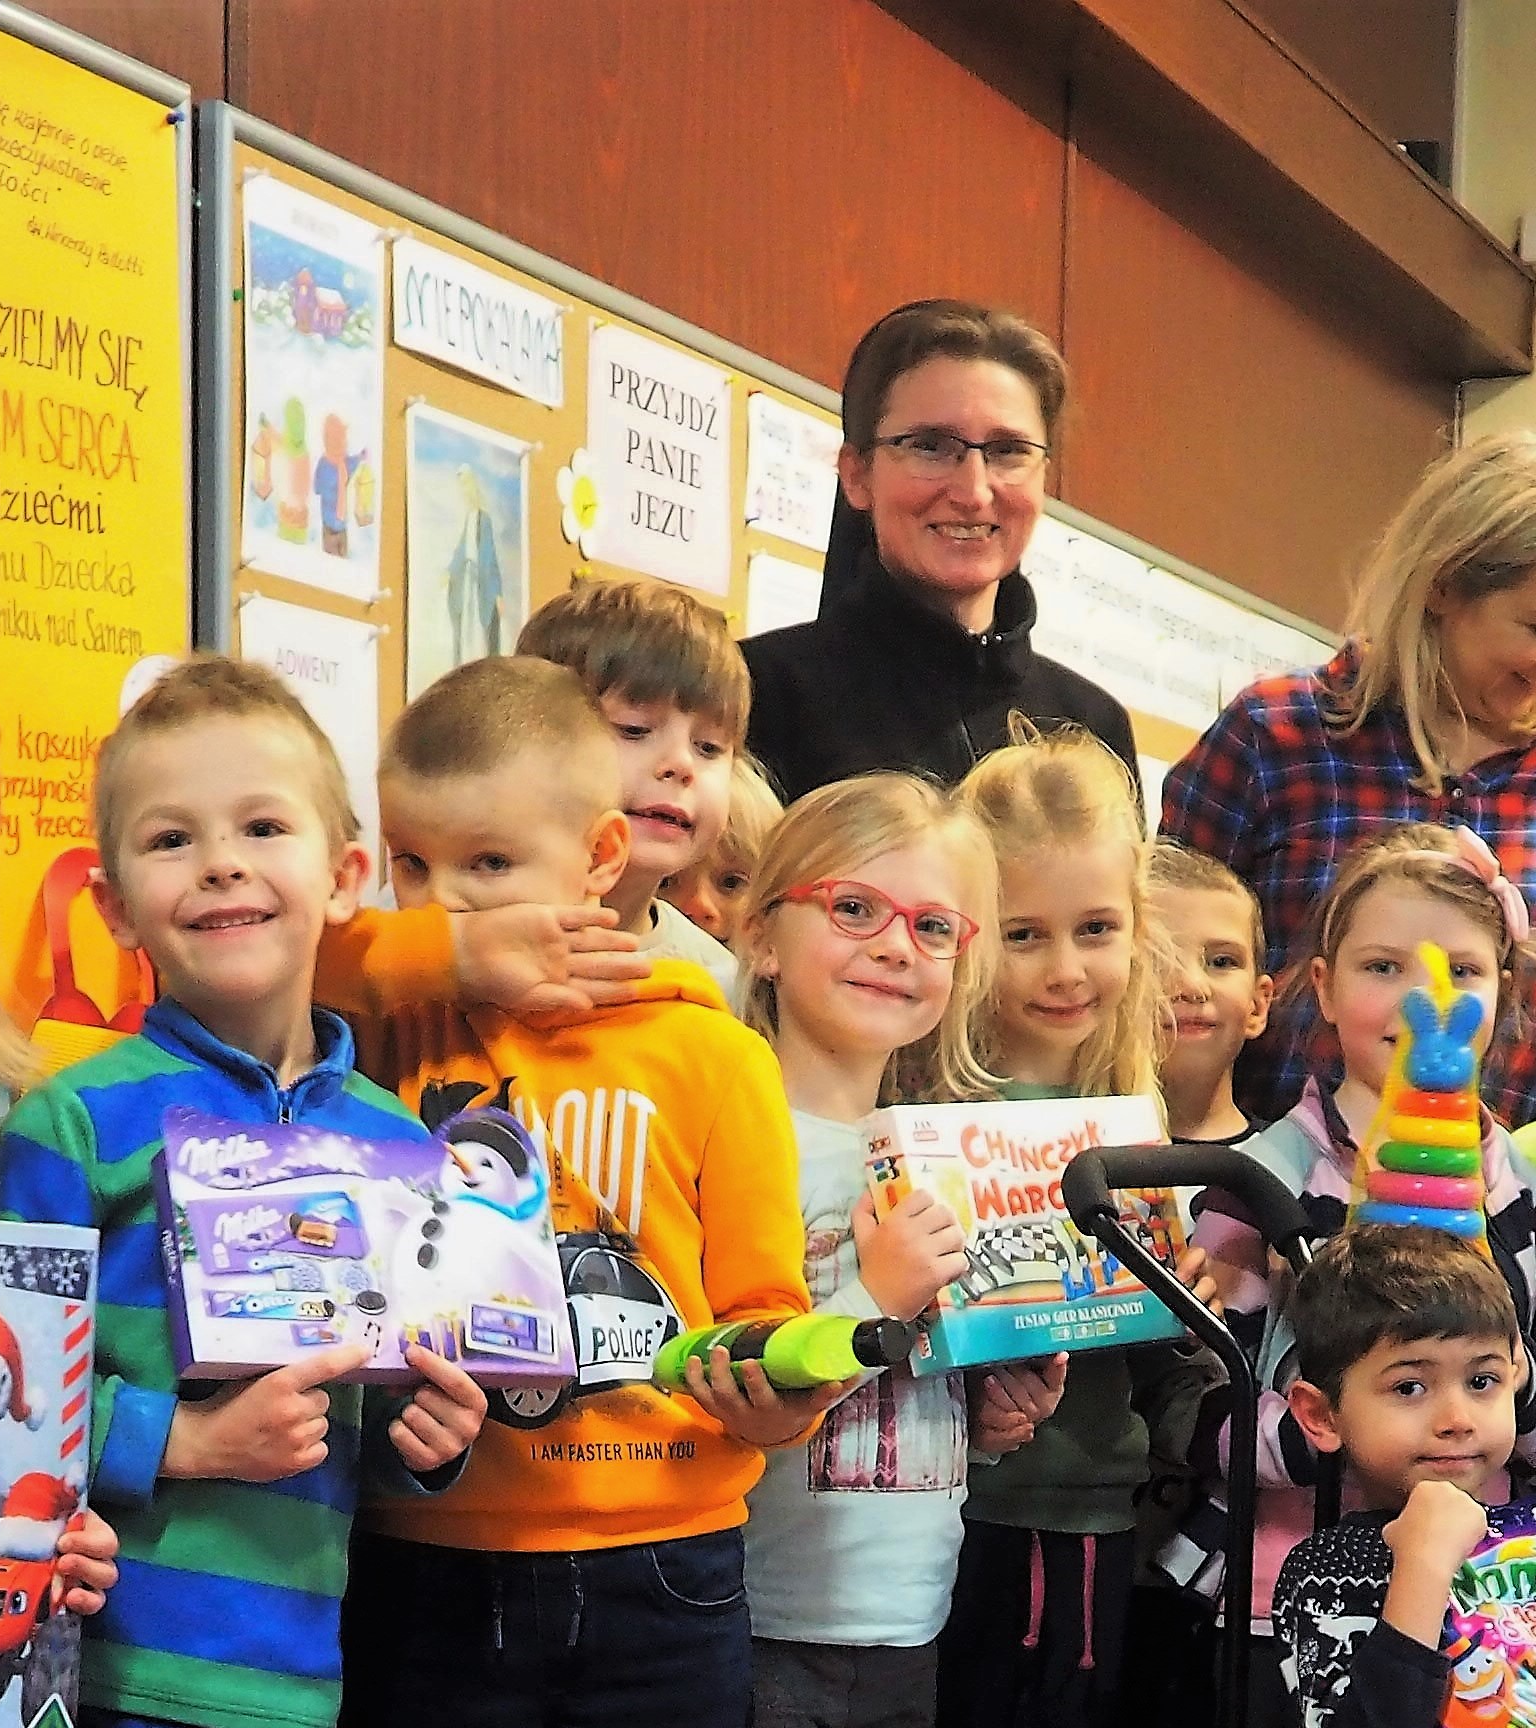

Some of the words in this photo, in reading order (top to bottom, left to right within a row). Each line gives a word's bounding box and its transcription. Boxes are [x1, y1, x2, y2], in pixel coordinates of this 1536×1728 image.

[95, 329, 148, 412] SIĘ
[609, 361, 718, 440] PRZYJDŹ
[38, 397, 141, 482] SERCA
[626, 428, 702, 490] PANIE
[631, 490, 695, 542] JEZU
[34, 541, 136, 597] Dziecka
[47, 606, 77, 647] nad
[275, 647, 340, 686] ADWENT
[18, 714, 99, 780] koszyk
[36, 815, 96, 839] rzecz
[176, 1132, 274, 1177] Milka
[971, 1176, 1067, 1222] WARC
[214, 1203, 284, 1244] Milka
[592, 1325, 653, 1361] POLICE
[531, 1444, 537, 1461] I
[541, 1443, 563, 1461] AM
[568, 1443, 622, 1461] FASTER
[626, 1441, 663, 1461] THAN
[667, 1440, 696, 1459] YOU
